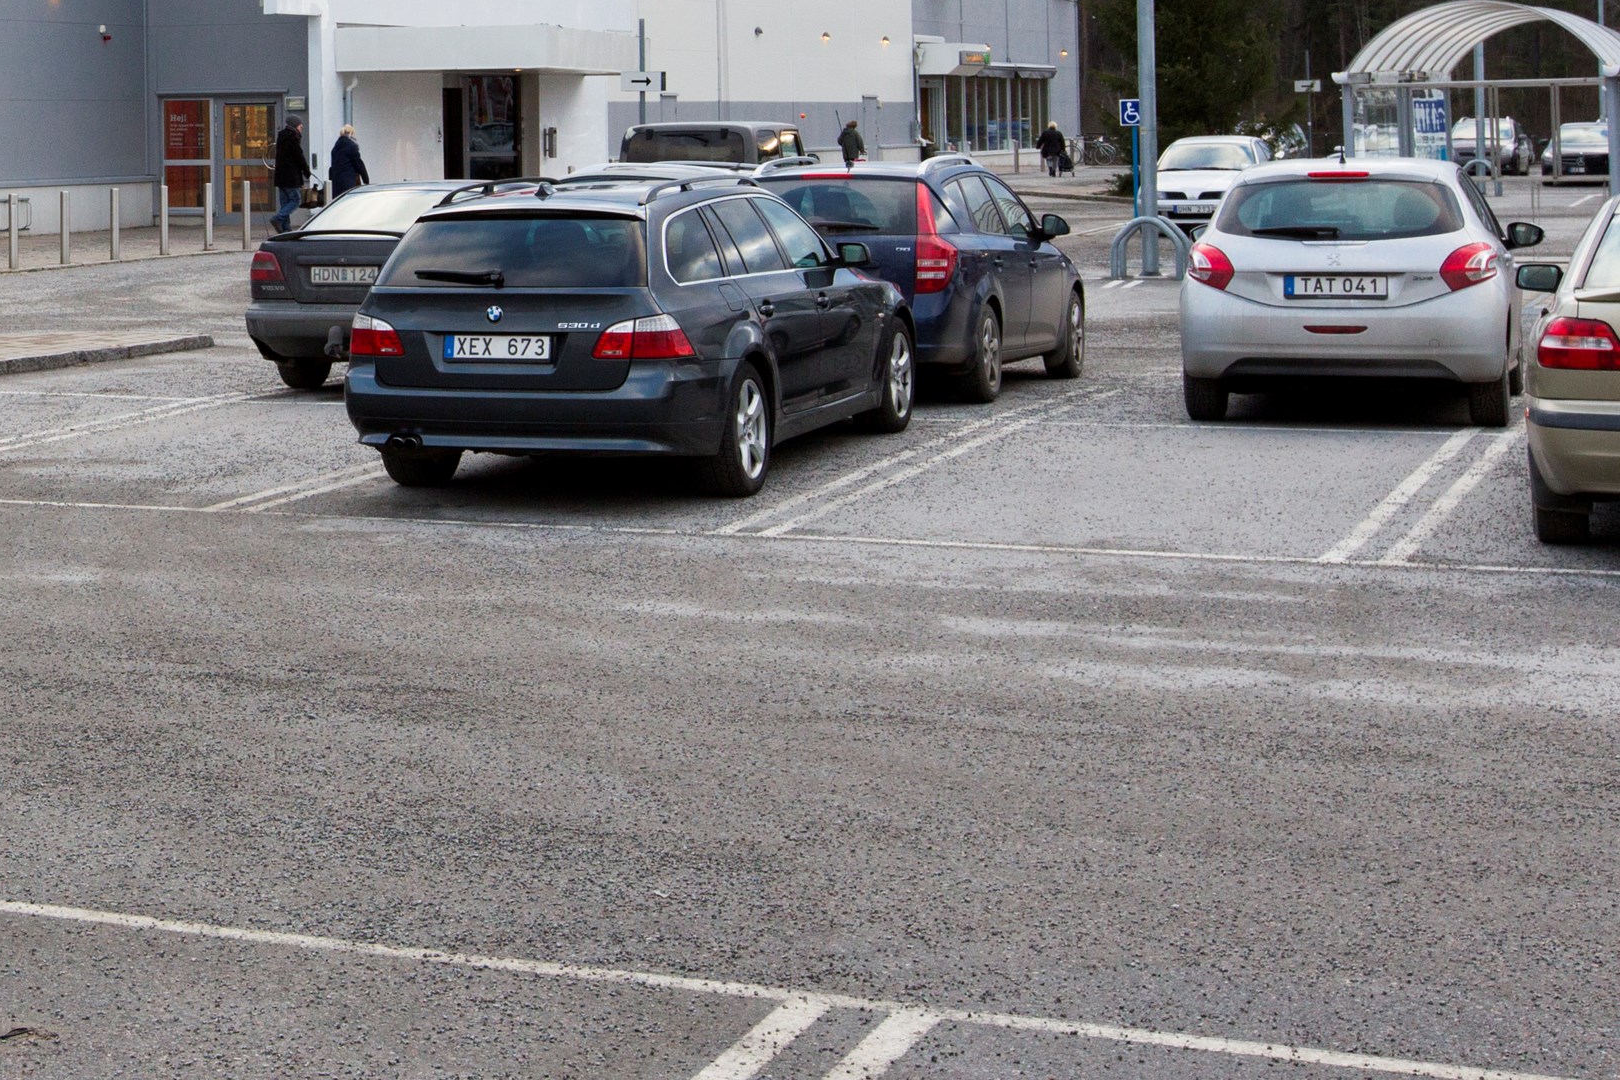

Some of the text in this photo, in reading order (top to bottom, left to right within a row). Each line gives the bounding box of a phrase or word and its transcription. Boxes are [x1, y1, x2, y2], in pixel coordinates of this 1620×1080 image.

[313, 268, 376, 281] HDN 124
[1301, 277, 1378, 293] TAT 041
[457, 337, 493, 356] XEX
[507, 338, 546, 357] 673
